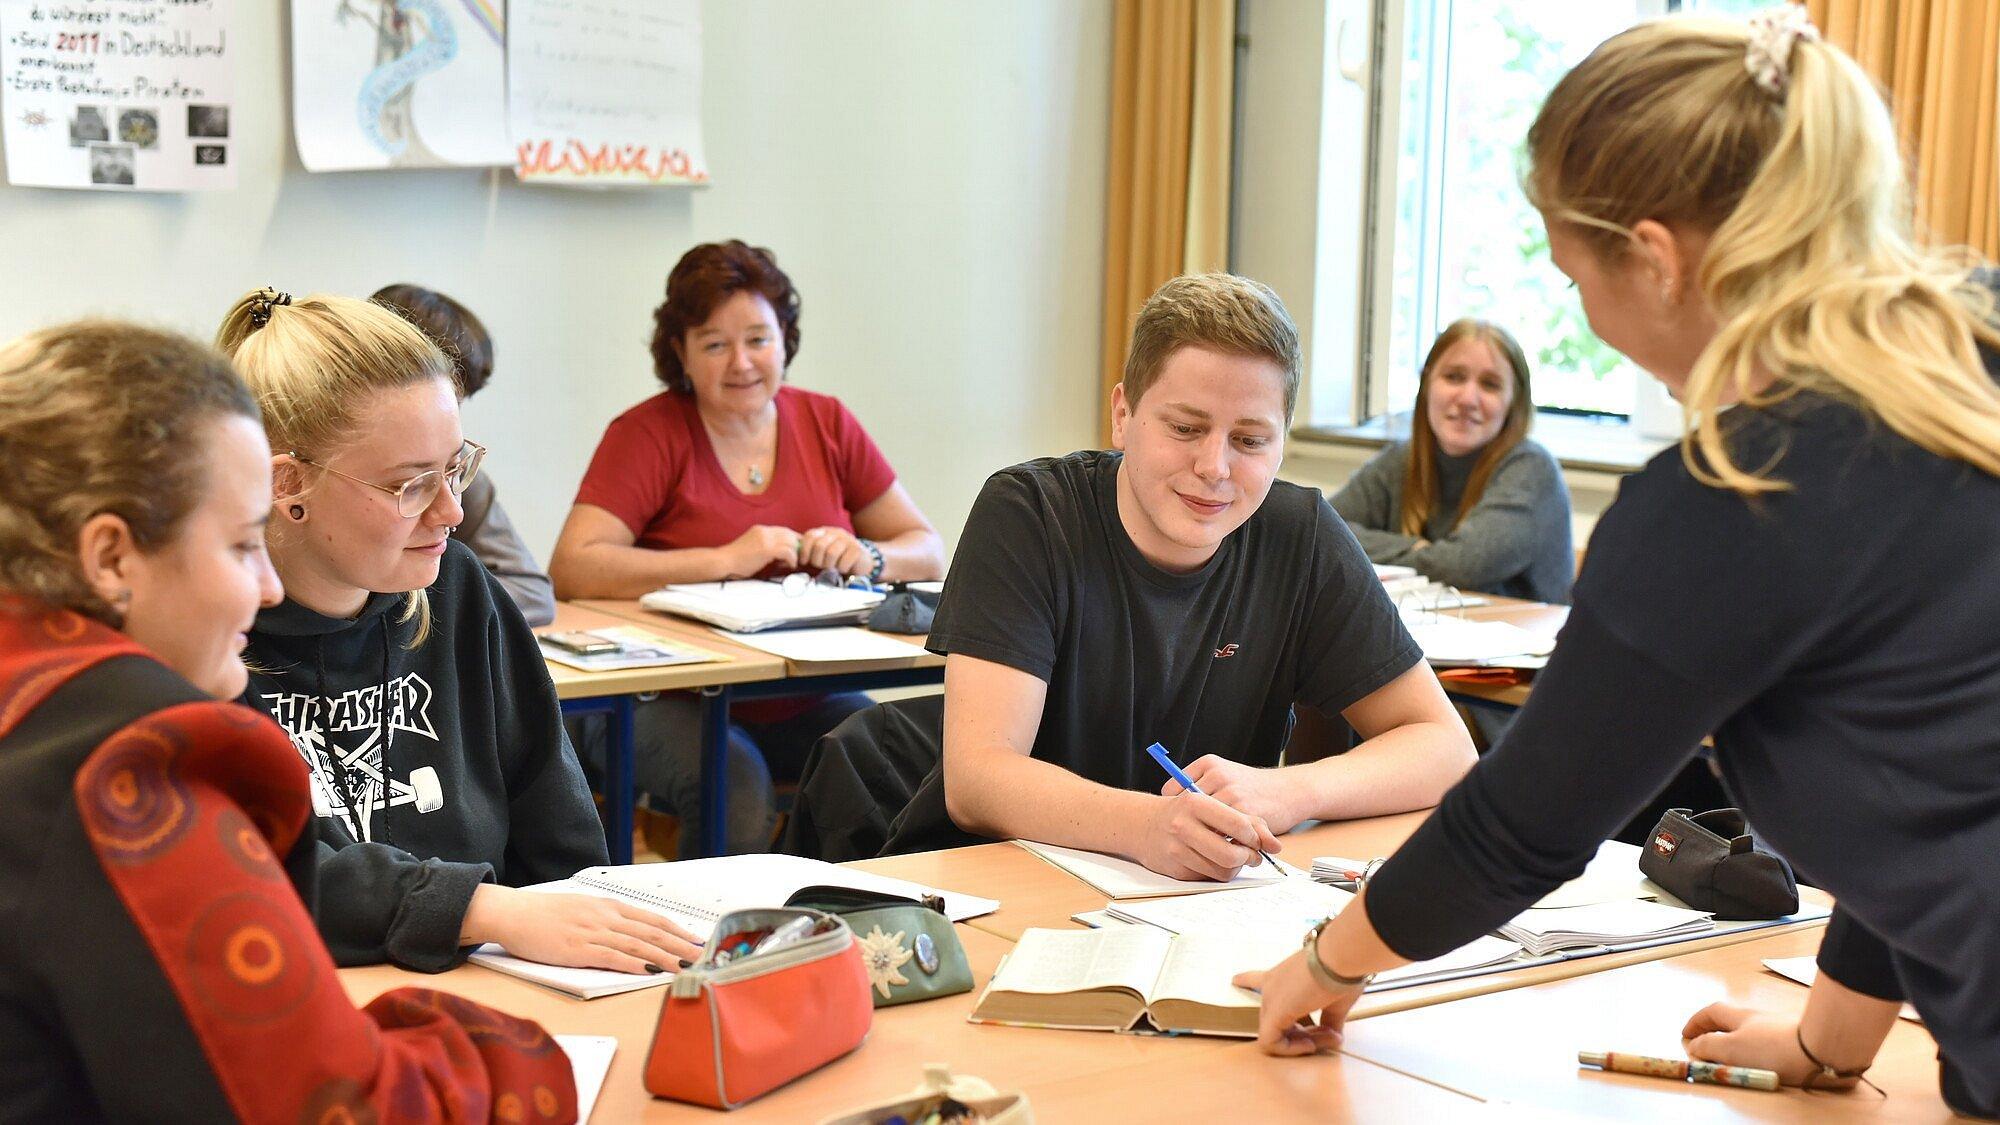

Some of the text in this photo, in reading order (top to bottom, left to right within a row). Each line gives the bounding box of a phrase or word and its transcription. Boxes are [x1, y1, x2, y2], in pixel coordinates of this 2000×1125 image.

[56, 31, 100, 54] 2011
[104, 33, 117, 53] in
[120, 29, 225, 57] Deutschland
[19, 56, 95, 74] anerkannt
[260, 671, 440, 742] THRASHER
